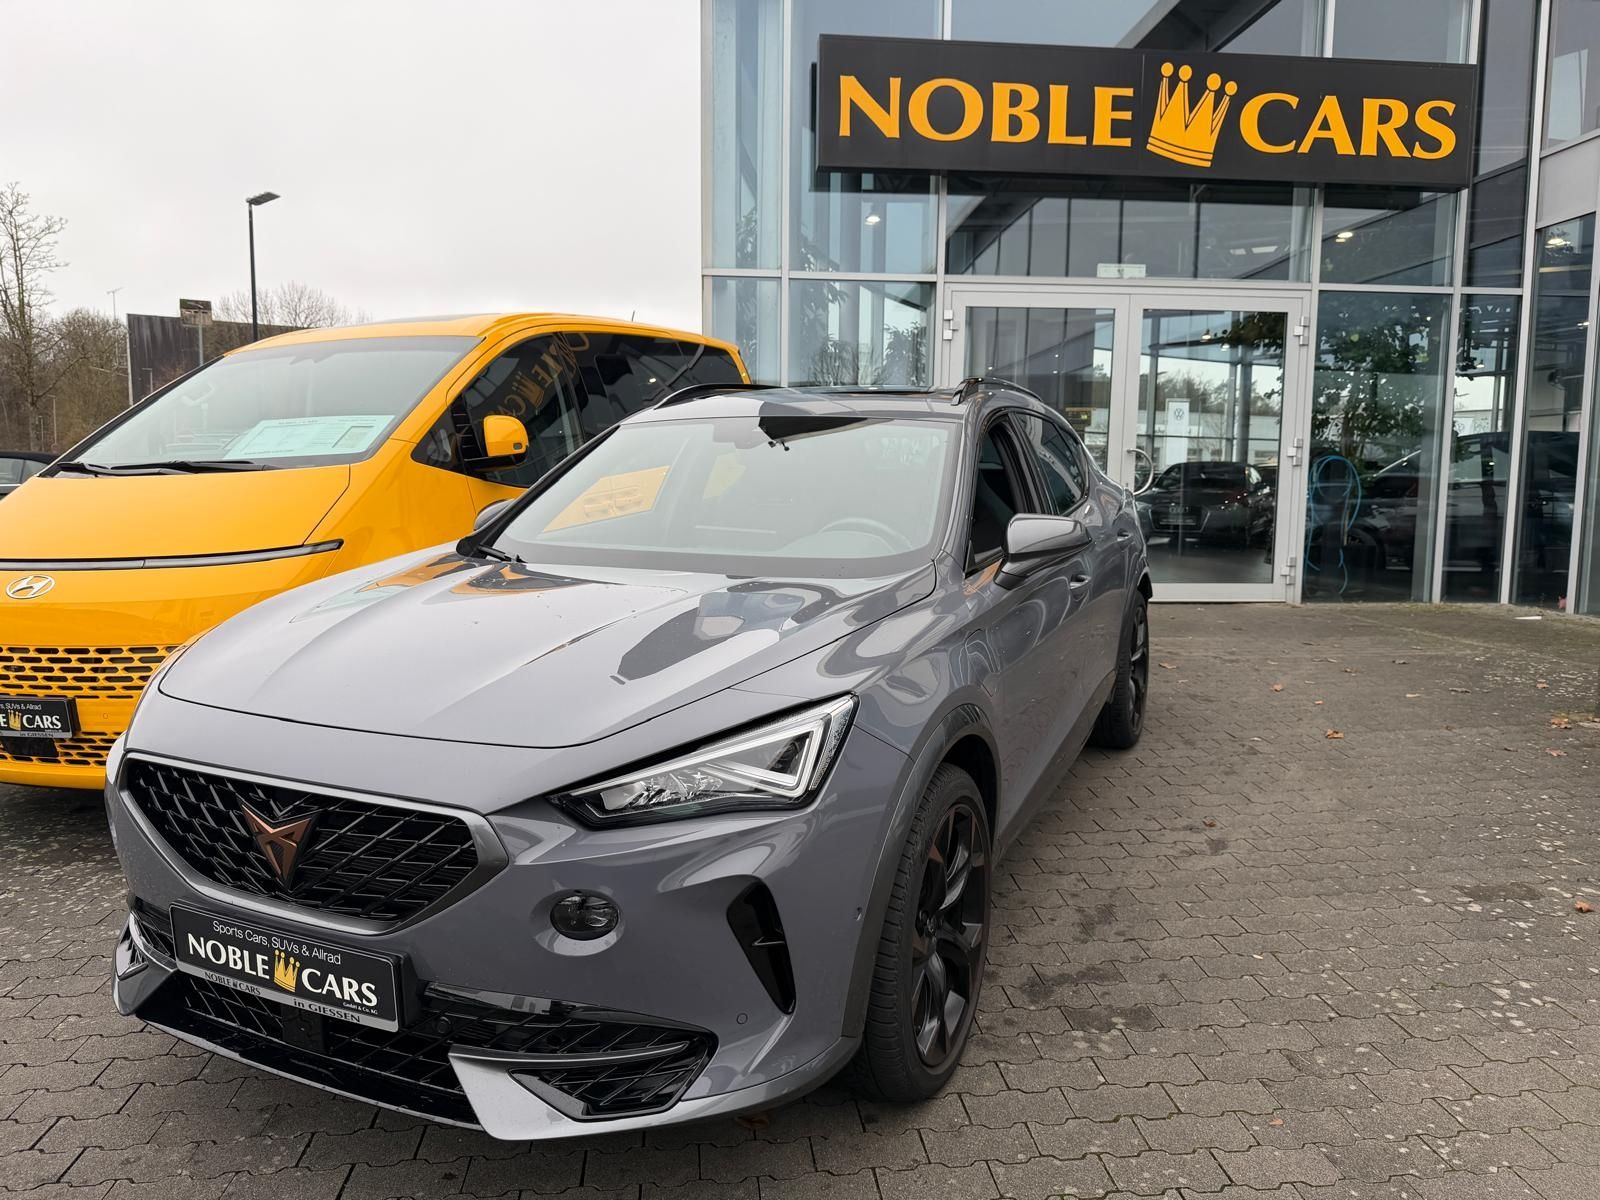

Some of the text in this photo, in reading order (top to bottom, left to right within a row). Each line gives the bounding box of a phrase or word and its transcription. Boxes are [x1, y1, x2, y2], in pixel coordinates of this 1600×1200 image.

[838, 74, 1456, 160] NOBLE CARS
[22, 714, 62, 729] CARS
[212, 920, 341, 965] Sports Cars, SUVs & Allrad
[187, 932, 378, 1007] NOBLE CARS
[204, 971, 261, 996] NOBLE CARS
[293, 998, 361, 1022] in GIESSEN
